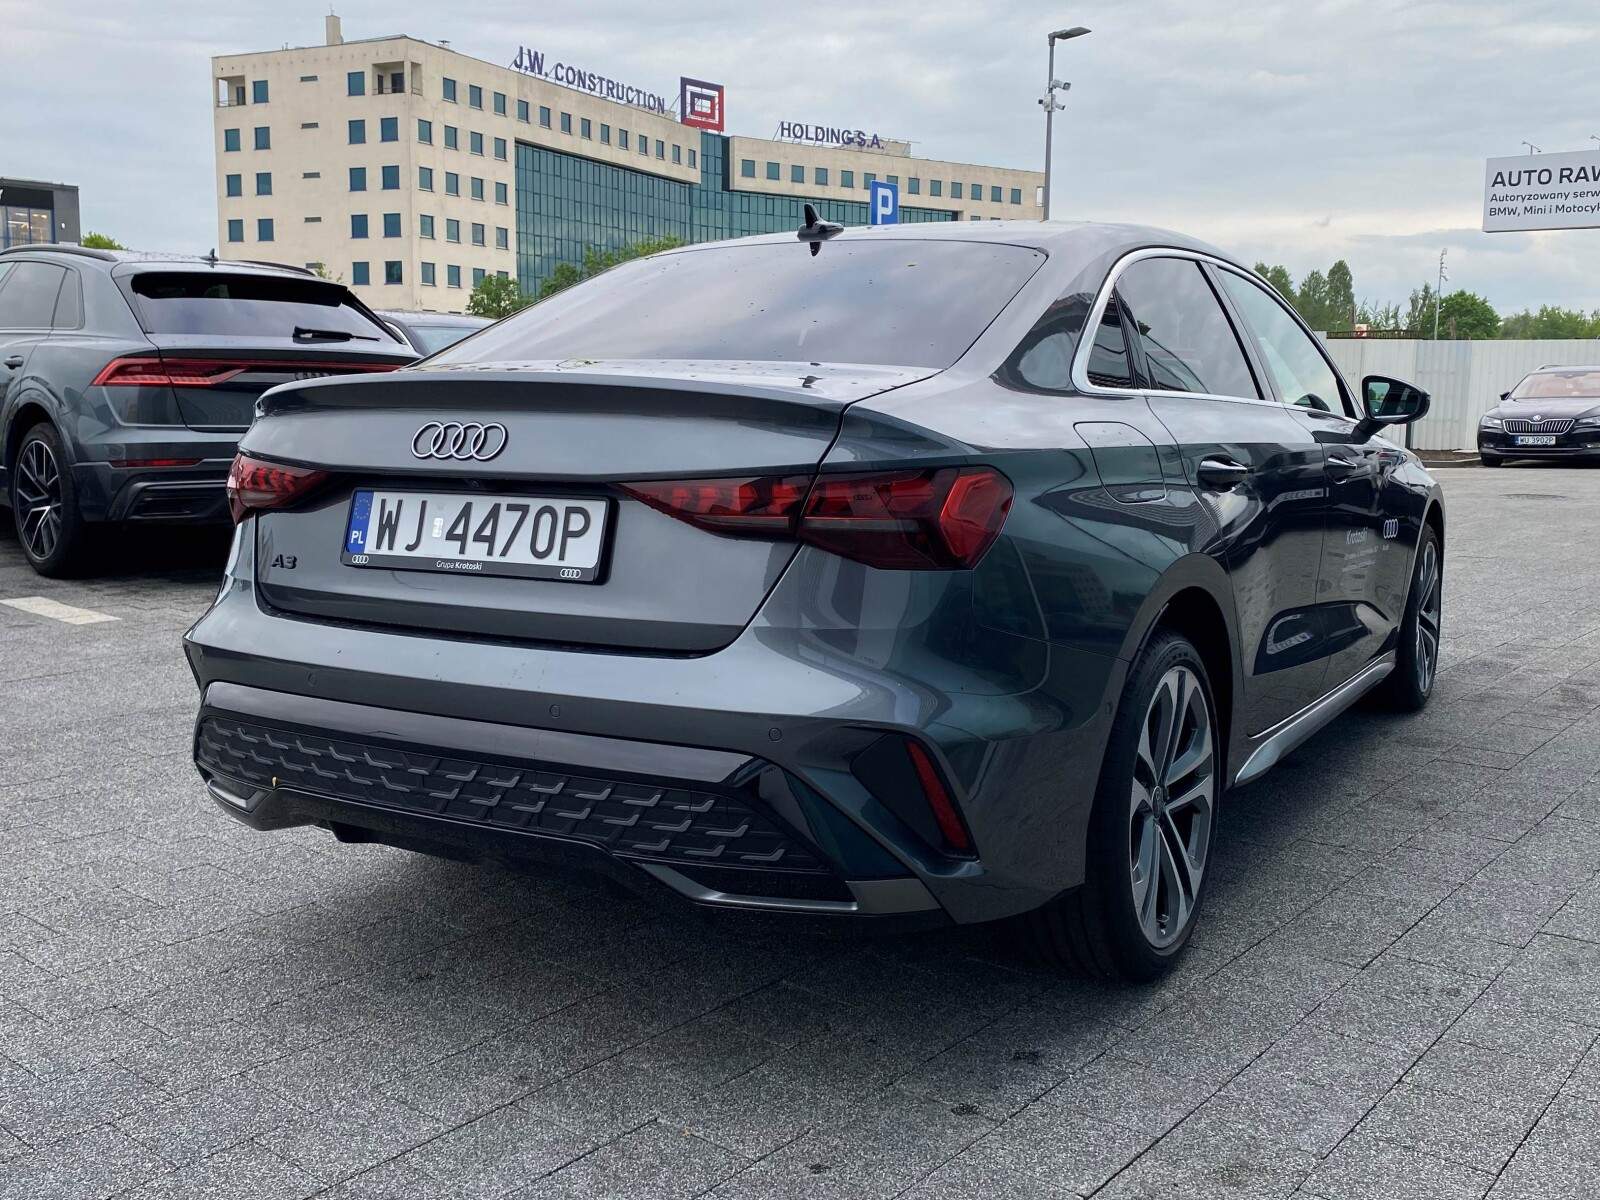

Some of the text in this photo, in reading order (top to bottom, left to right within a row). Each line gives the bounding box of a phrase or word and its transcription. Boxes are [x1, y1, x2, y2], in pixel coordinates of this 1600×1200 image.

[513, 45, 666, 115] J.W. CONSTRUCTION
[780, 121, 885, 149] HOLDING S.A.
[1491, 168, 1552, 187] AUTO
[876, 187, 894, 225] P
[1490, 192, 1570, 203] Autoryzowany
[1489, 206, 1521, 217] BMW,
[1523, 205, 1546, 215] Mini
[350, 530, 364, 545] PL
[375, 498, 591, 561] WJ 4470P
[272, 553, 298, 570] A3
[436, 560, 482, 570] Grupa Krotoski
